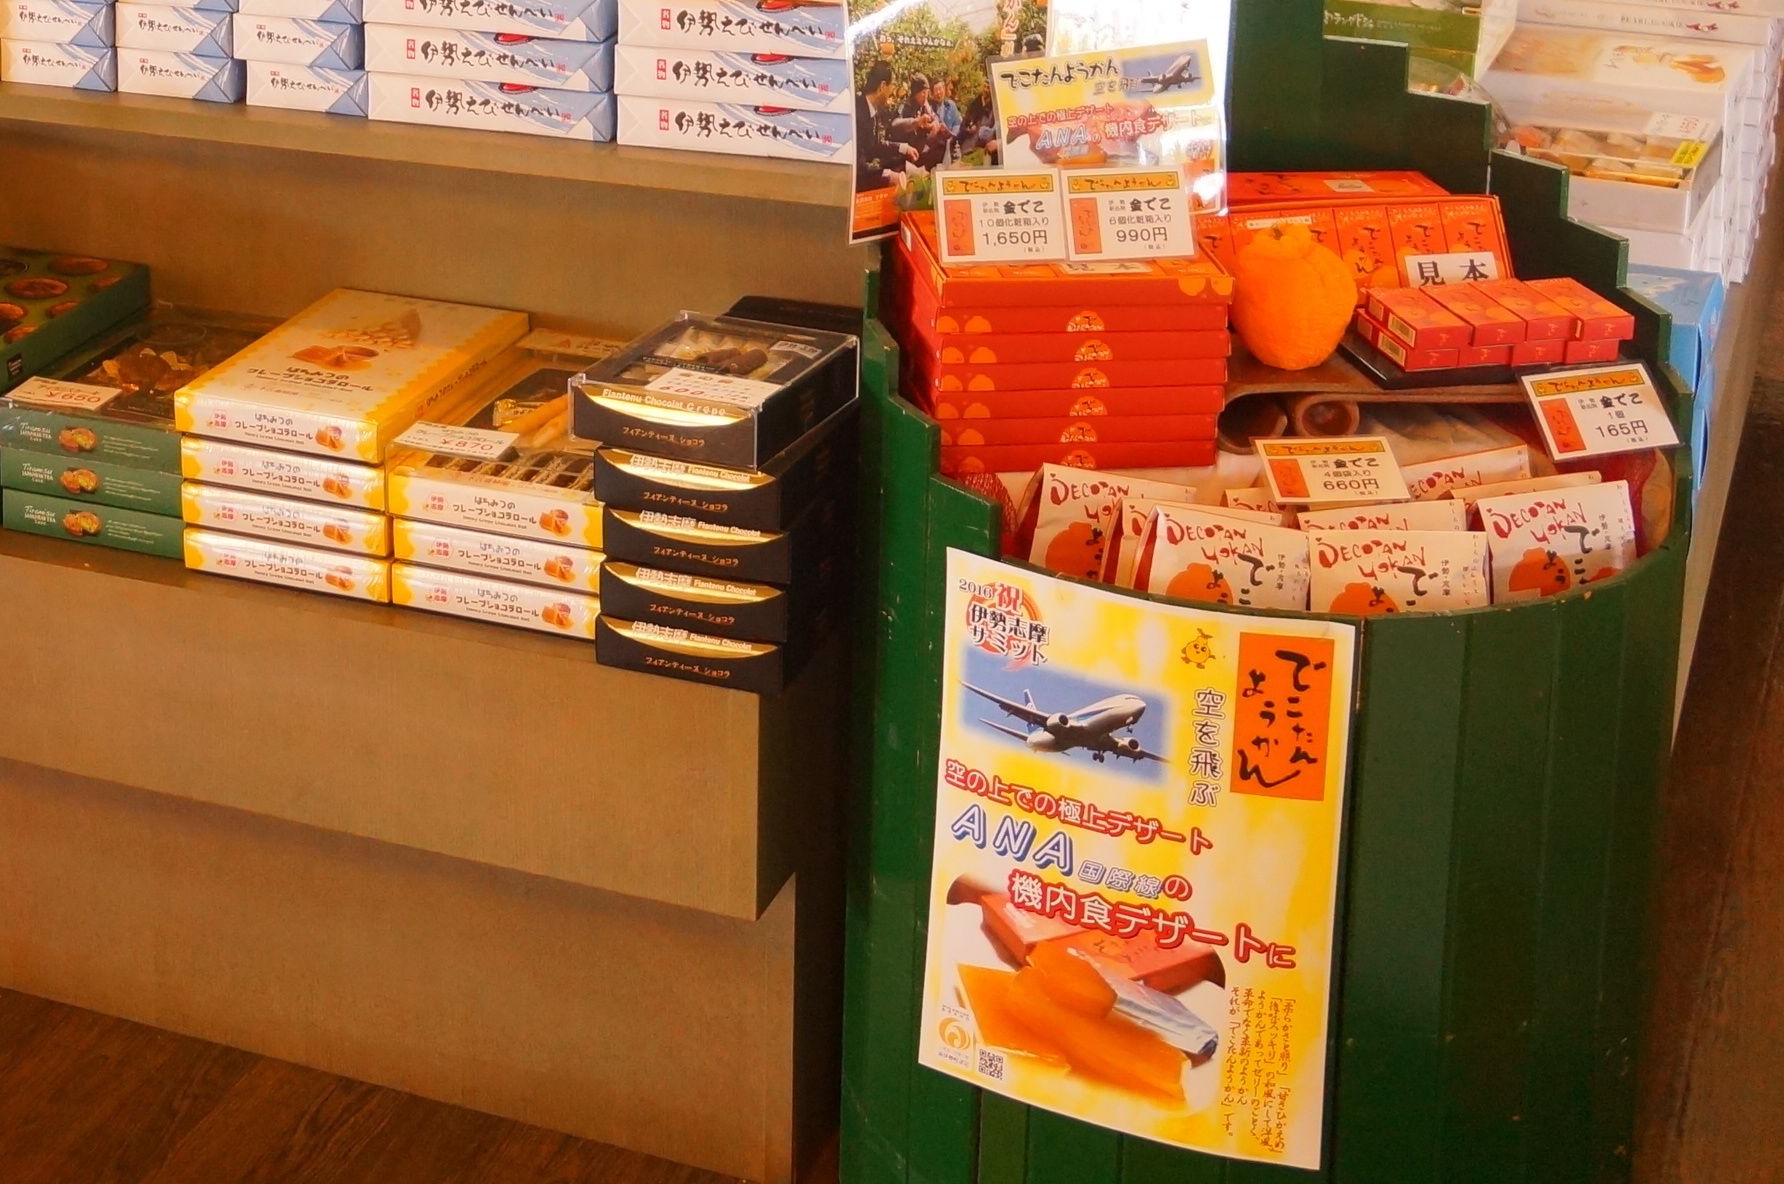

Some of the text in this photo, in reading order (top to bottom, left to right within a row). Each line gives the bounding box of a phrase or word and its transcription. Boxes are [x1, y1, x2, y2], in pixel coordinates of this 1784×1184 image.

[677, 10, 824, 36] 伊勢えびせんべい
[421, 40, 554, 67] 伊勢えびせんべい
[673, 61, 817, 88] 伊勢えびせんべい
[1001, 59, 1119, 89] でこたんようかん
[426, 89, 559, 117] 伊勢えびせんべい
[675, 112, 820, 138] 伊勢えびせんべい
[1036, 125, 1089, 149] ANA
[1003, 199, 1046, 215] 金でこ
[1129, 198, 1172, 212] 金でこ
[979, 217, 1050, 228] 10個化粧箱入り
[1109, 214, 1172, 225] 6個化粧箱入り
[982, 228, 1048, 246] 1,650円
[1115, 227, 1168, 243] 990円
[1416, 259, 1489, 286] 見本
[644, 395, 683, 409] Chocolat
[1600, 392, 1643, 408] 金でこ
[1595, 420, 1649, 438] 165円
[1333, 456, 1380, 469] 金でこ
[1322, 478, 1380, 491] 660円
[474, 496, 516, 509] はちみつの
[959, 578, 1024, 613] 2016 祝
[971, 603, 1049, 643] 伊勢志摩
[970, 625, 1047, 666] サミット
[1275, 649, 1326, 764] でこたん
[1237, 669, 1301, 788] ようかん
[1188, 688, 1226, 807] 空を飛ぶ
[945, 759, 1213, 855] 空の上での極上デザート
[1009, 869, 1296, 969] 機内食デザートに
